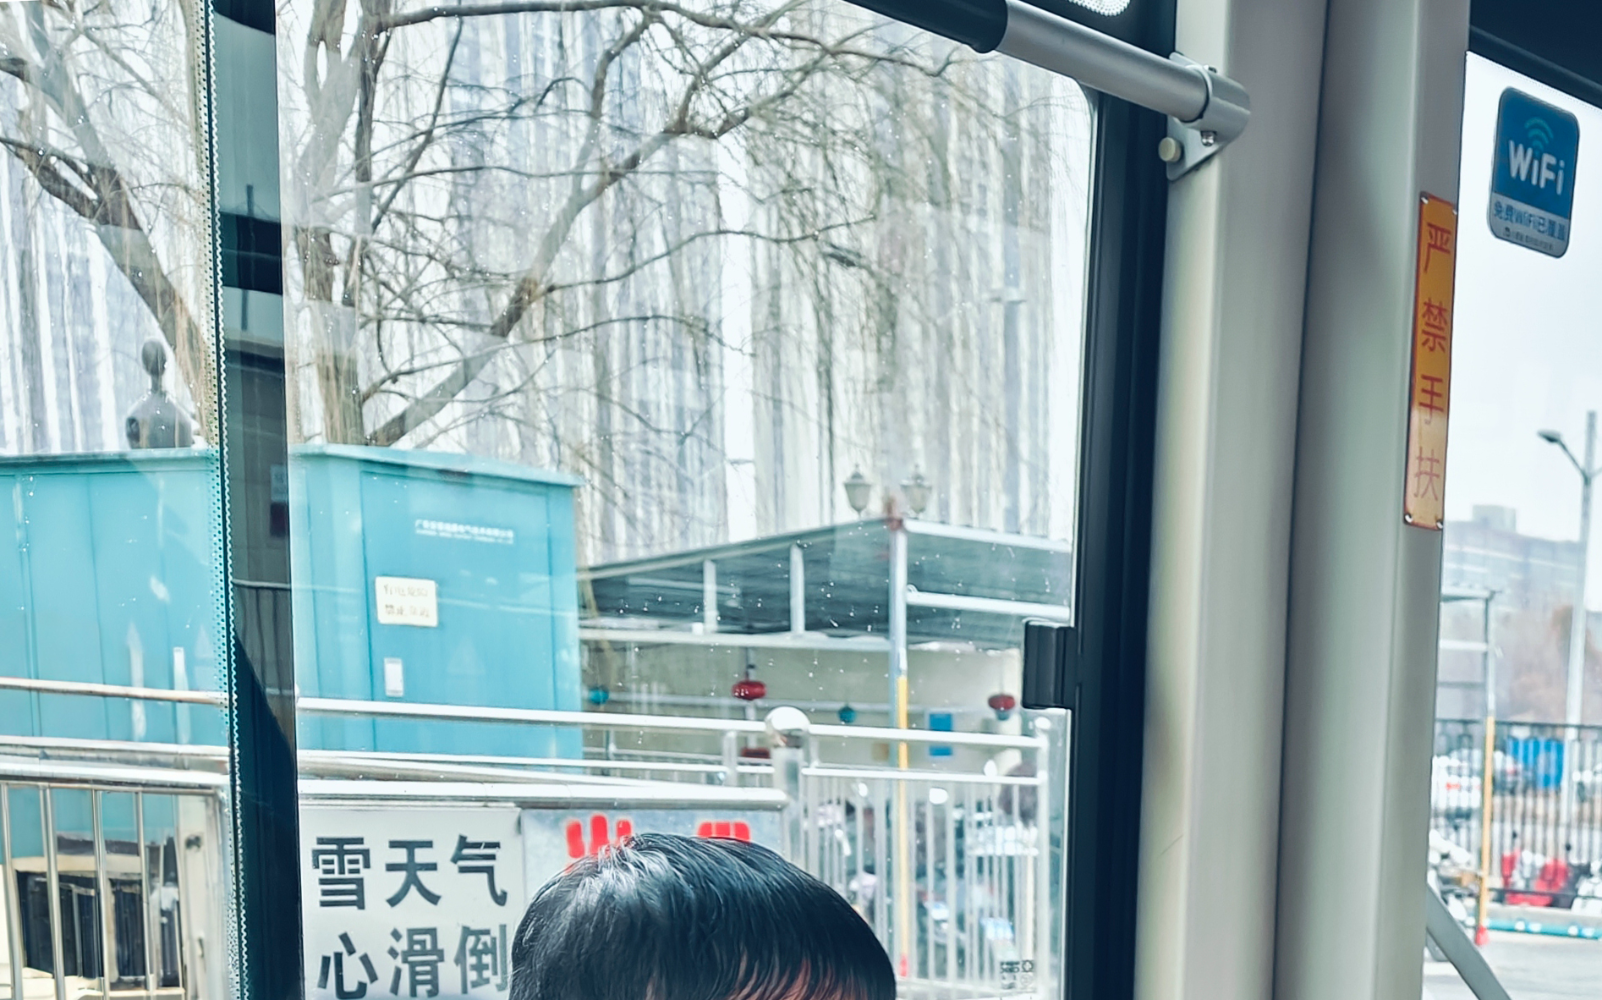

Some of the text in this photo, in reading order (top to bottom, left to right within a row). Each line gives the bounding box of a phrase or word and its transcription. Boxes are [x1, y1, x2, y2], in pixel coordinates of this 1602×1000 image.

[1508, 139, 1565, 196] WiFi
[1413, 221, 1452, 502] 严禁手扶
[312, 834, 508, 911] 雪天气
[317, 923, 508, 1000] 心滑倒
